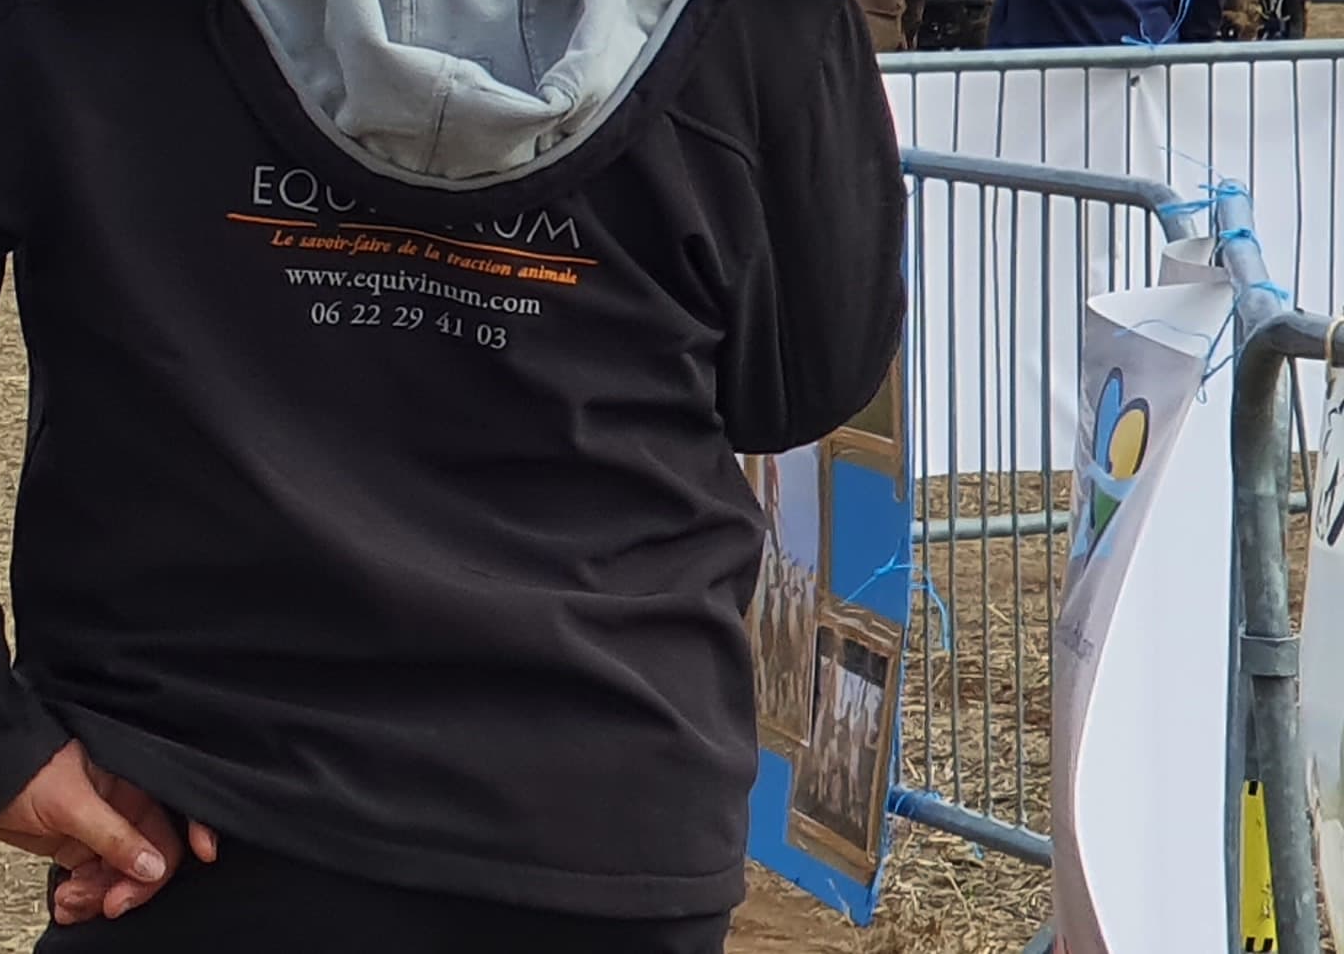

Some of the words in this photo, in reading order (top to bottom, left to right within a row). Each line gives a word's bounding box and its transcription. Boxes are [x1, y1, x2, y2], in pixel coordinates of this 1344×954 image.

[253, 166, 580, 248] EQUUM
[272, 230, 294, 247] Le
[299, 235, 392, 255] savoir-faire
[397, 240, 418, 255] de
[423, 243, 441, 260] la
[447, 252, 512, 276] traction
[517, 264, 578, 285] animale
[285, 268, 541, 315] www.equivinum.com
[311, 301, 342, 324] 06
[350, 304, 381, 325] 22
[392, 307, 424, 330] 29
[435, 311, 463, 337] 41
[476, 324, 507, 350] 03
